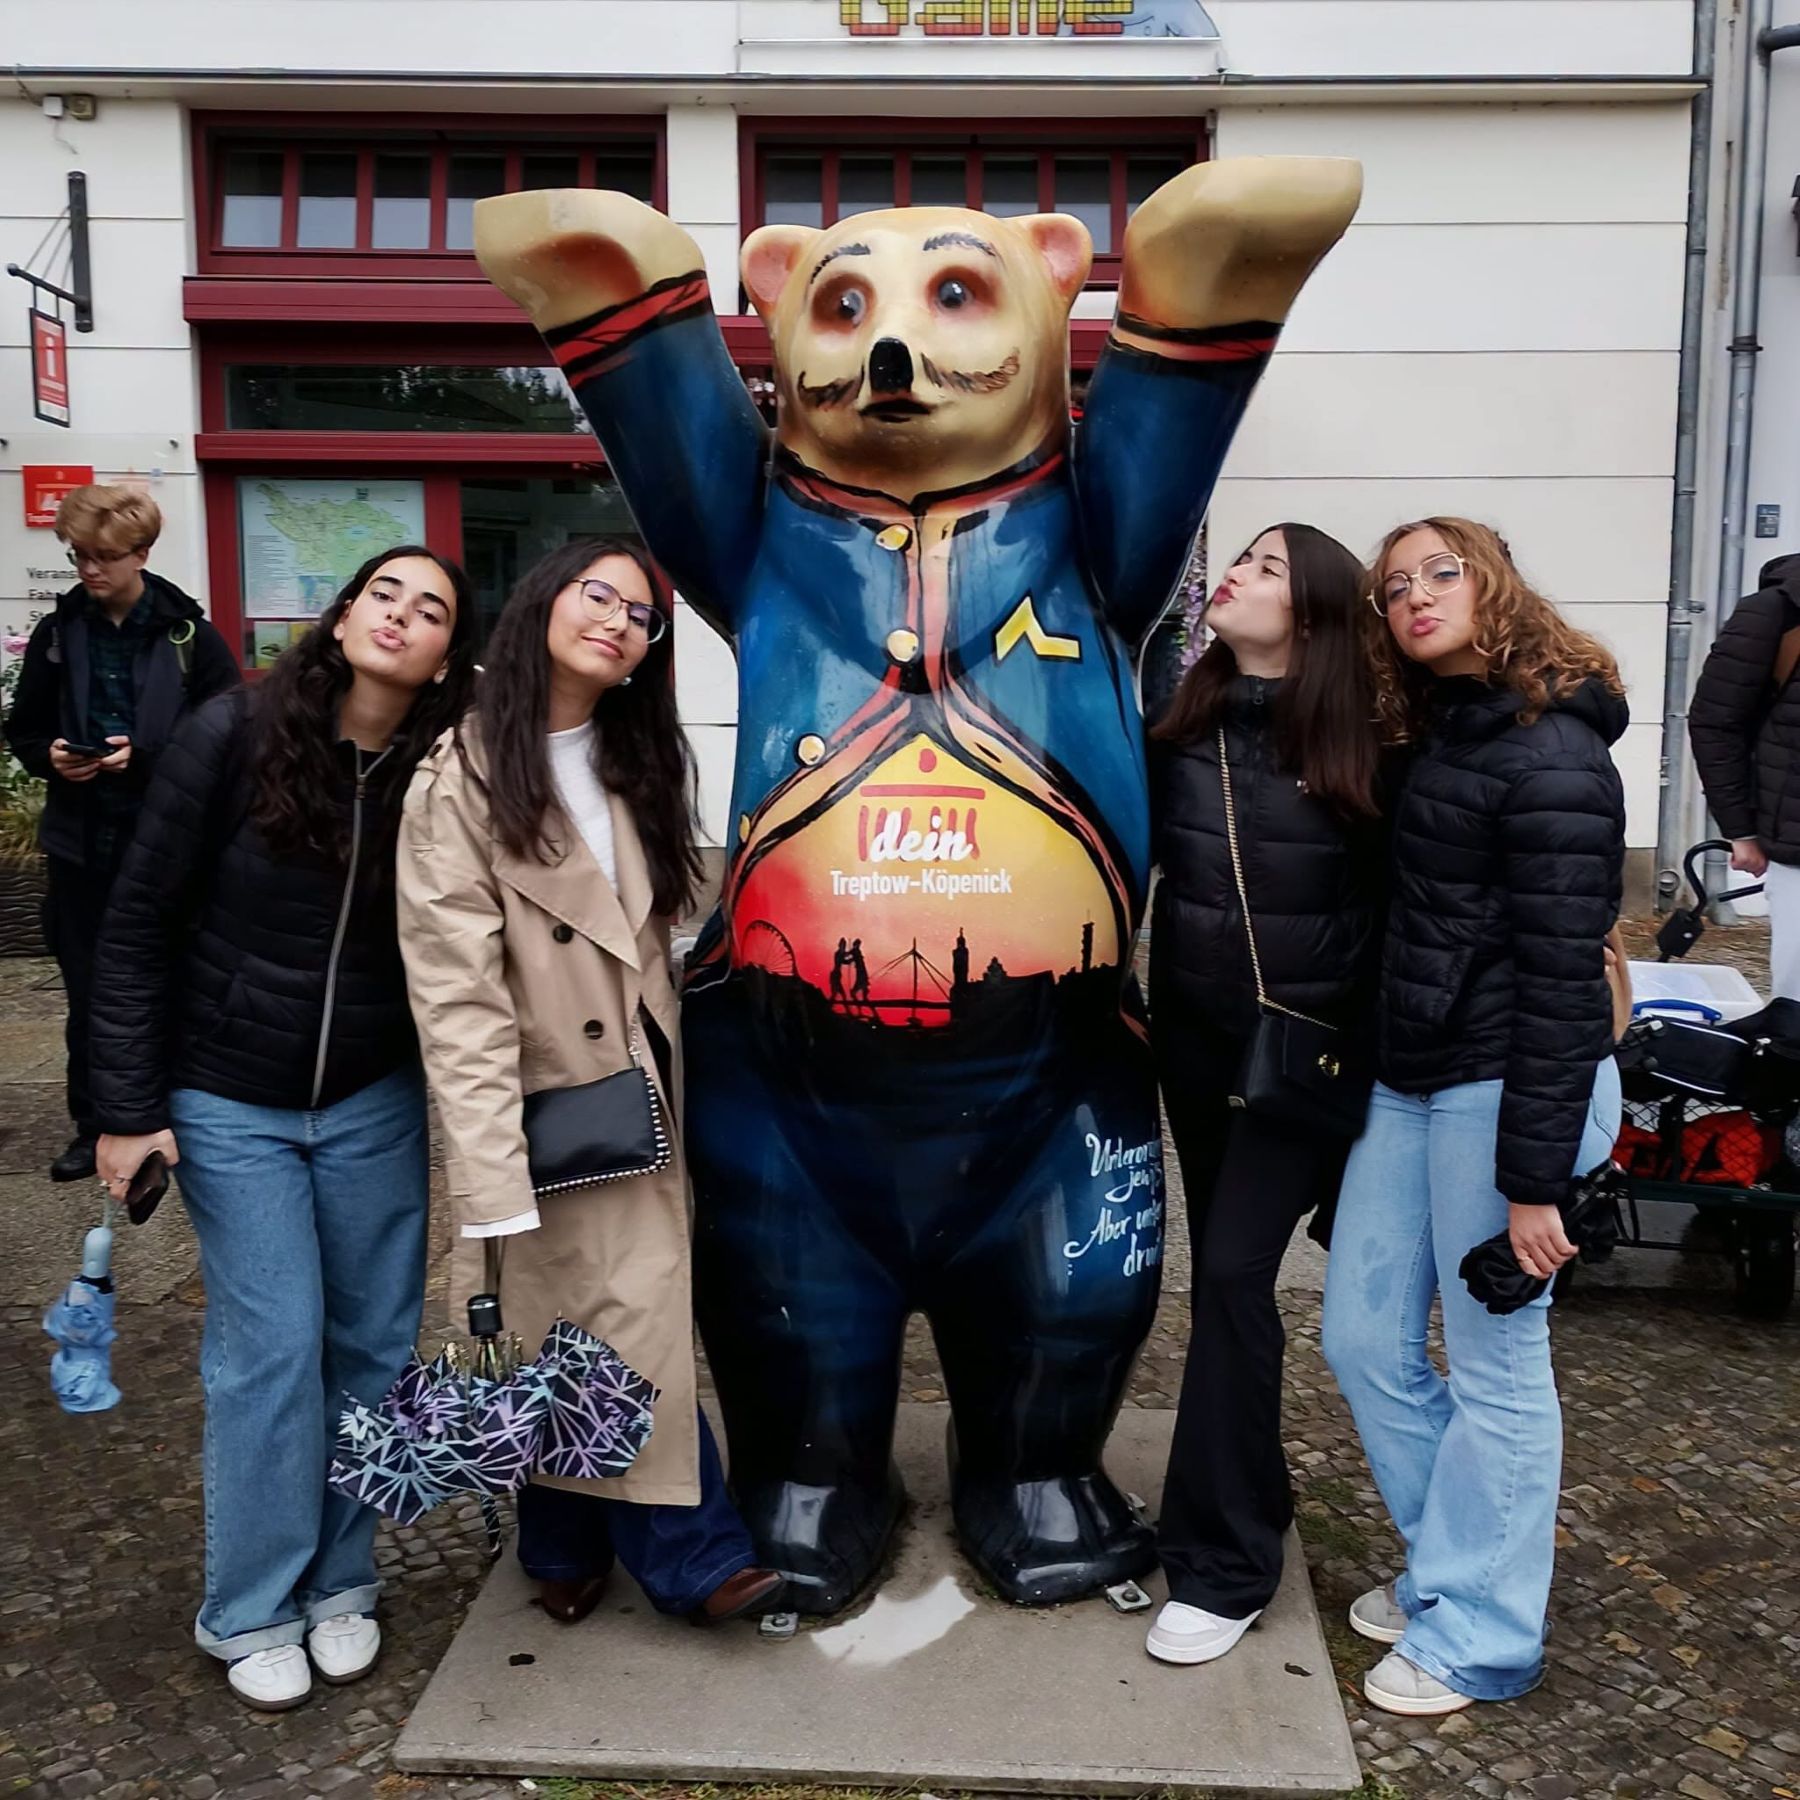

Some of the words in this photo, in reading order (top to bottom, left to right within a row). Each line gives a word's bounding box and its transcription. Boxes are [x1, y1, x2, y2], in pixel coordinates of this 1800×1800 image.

[870, 811, 974, 863] dein
[830, 868, 1012, 901] Treptow-Köpenick
[1063, 1206, 1132, 1258] Aber
